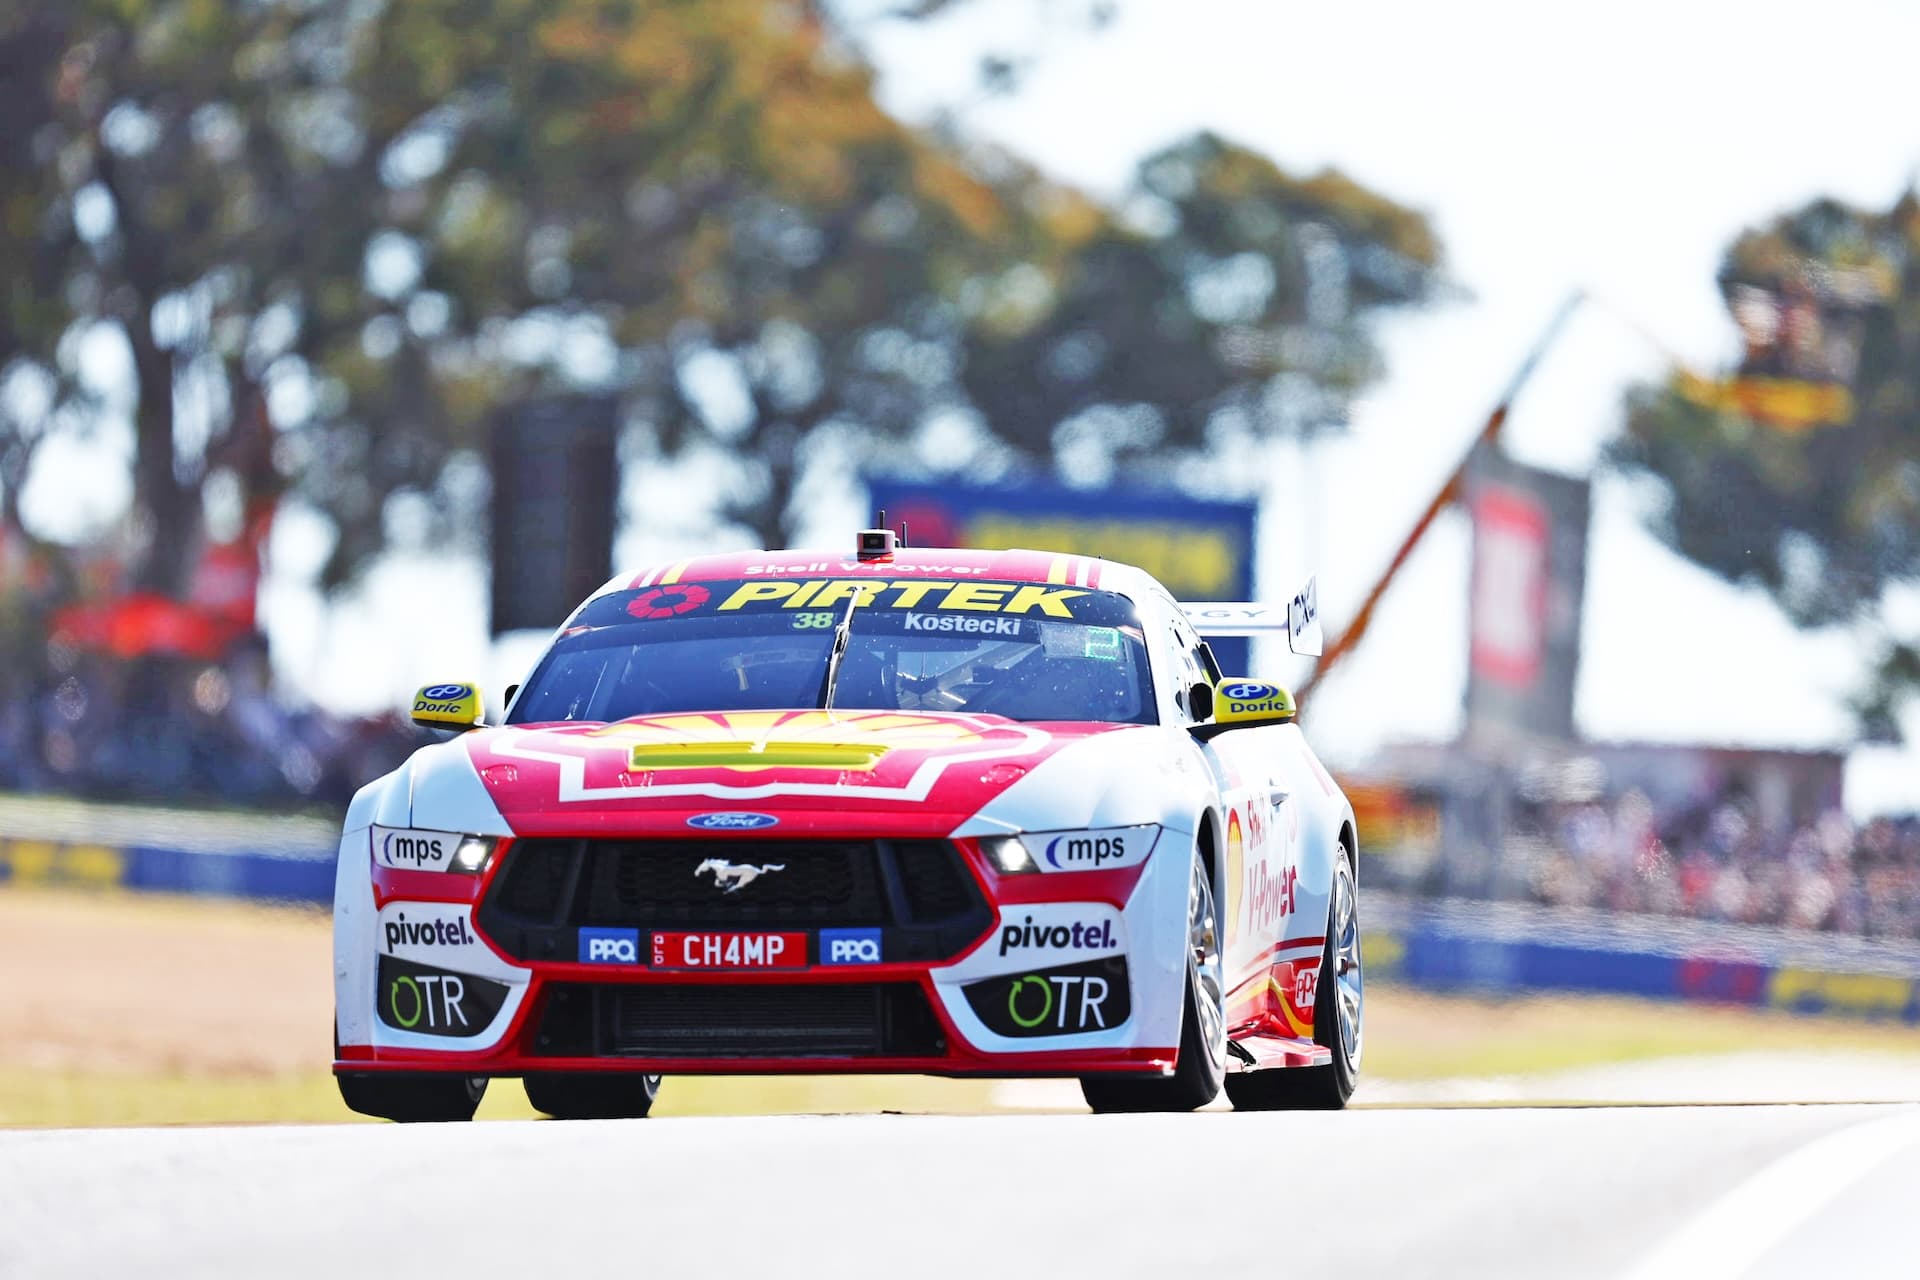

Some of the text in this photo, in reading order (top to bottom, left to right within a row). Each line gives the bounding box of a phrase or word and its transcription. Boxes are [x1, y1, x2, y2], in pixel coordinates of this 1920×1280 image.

[744, 562, 989, 575] Shell V-Power
[718, 579, 1092, 619] PIRTEK
[792, 612, 835, 629] 38
[904, 612, 1021, 636] Kostecki
[414, 701, 462, 713] Doric
[1230, 700, 1285, 713] Doric
[703, 813, 761, 827] Ford
[396, 837, 443, 867] mps
[1067, 836, 1125, 866] mps
[1248, 859, 1297, 937] V-Power
[385, 912, 475, 953] pivotel.
[999, 915, 1118, 957] pivotel.
[589, 938, 636, 962] PPQ
[683, 935, 785, 965] CH4MP
[831, 939, 879, 962] PPQ
[391, 975, 469, 1028] OTR
[1008, 974, 1109, 1029] OTR
